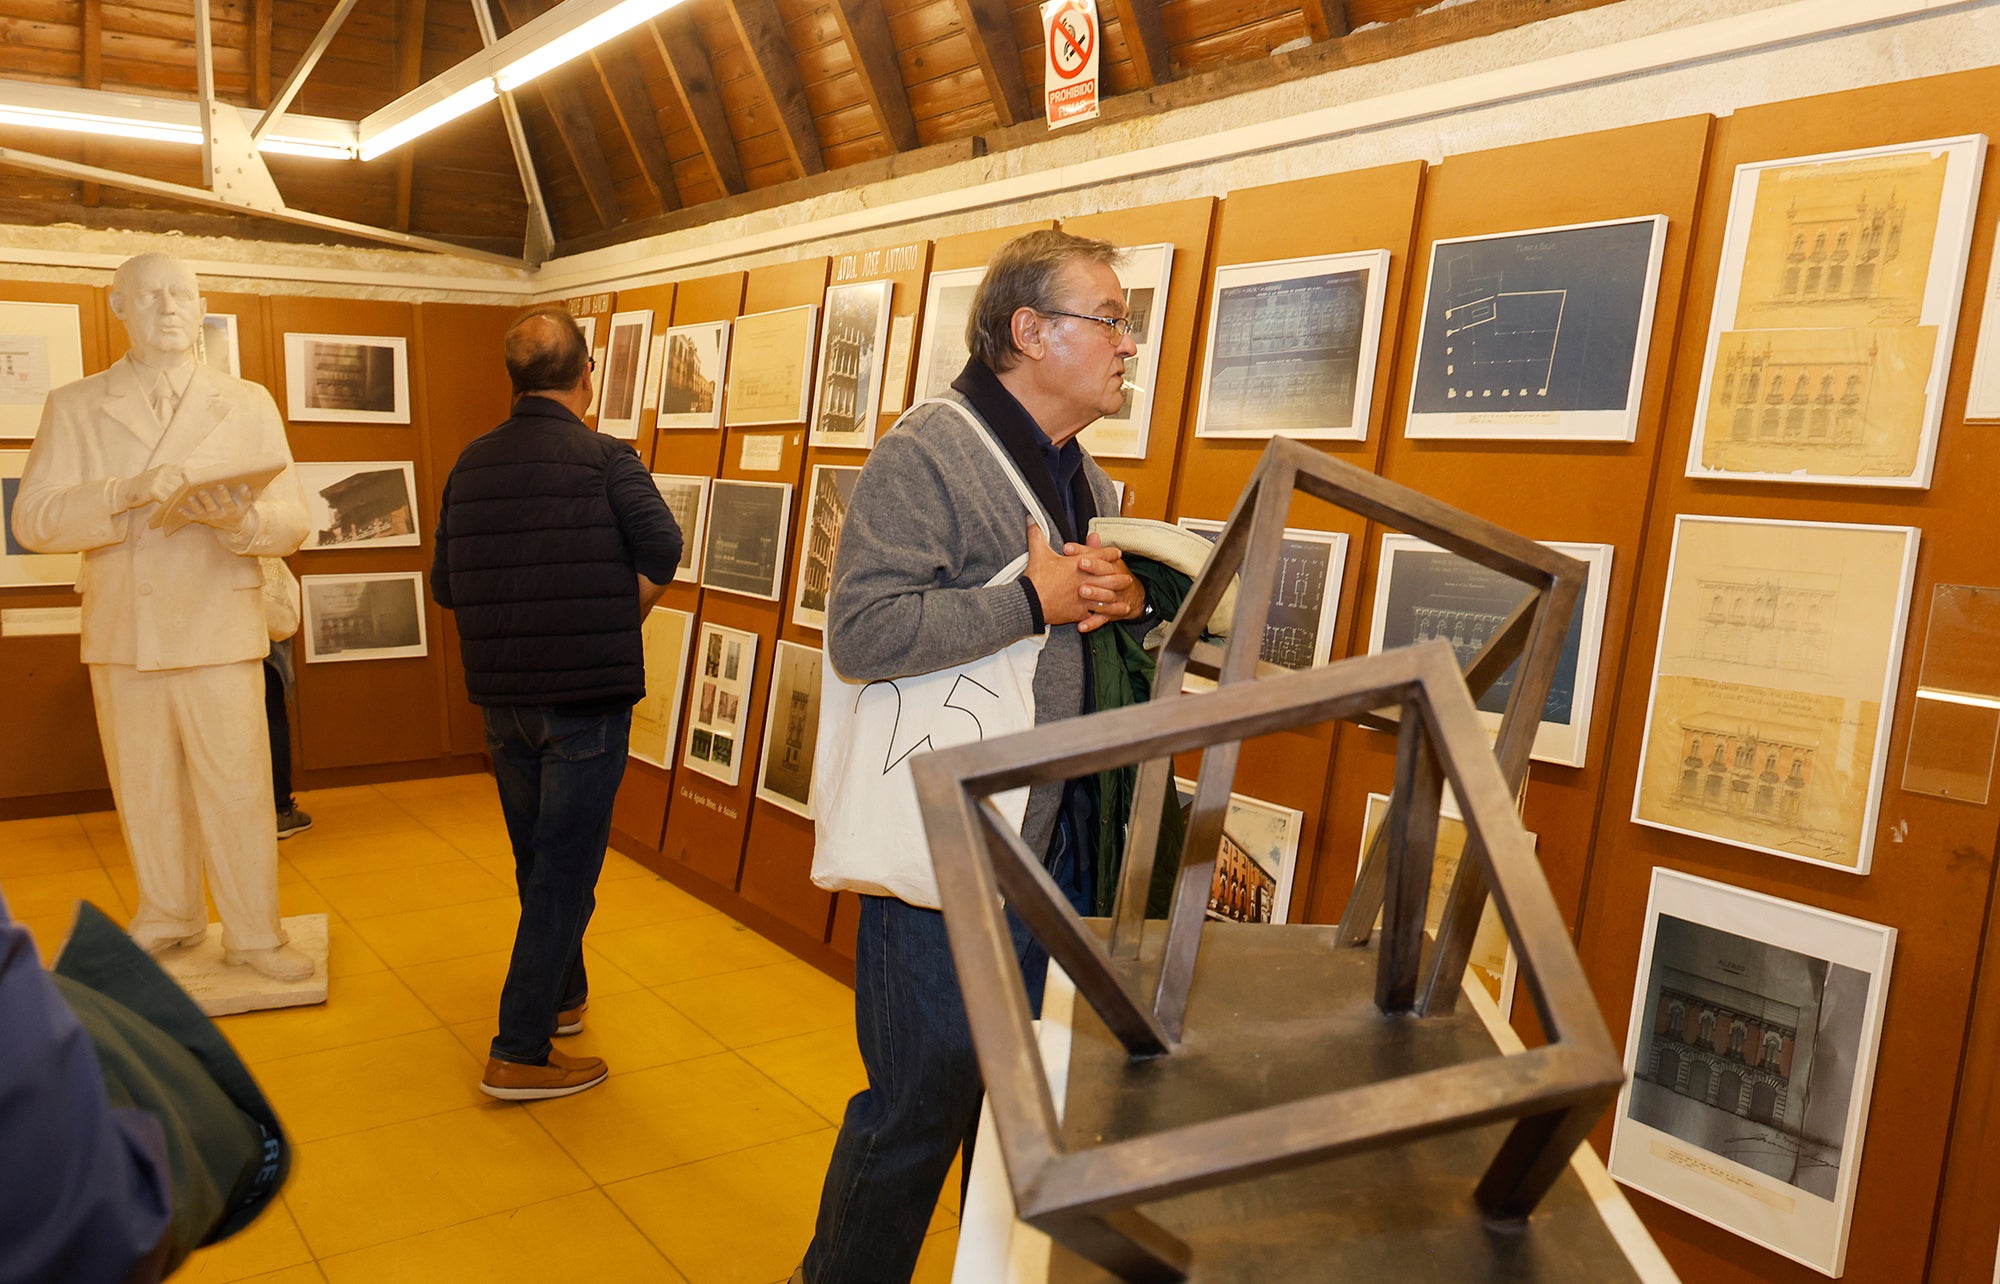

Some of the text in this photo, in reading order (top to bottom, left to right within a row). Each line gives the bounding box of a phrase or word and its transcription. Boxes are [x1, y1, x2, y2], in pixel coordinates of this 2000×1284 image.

[1049, 80, 1094, 105] PROHIBIDO
[1058, 100, 1087, 118] FUMAR
[862, 250, 881, 277] JOSE
[883, 243, 919, 275] ANTONIO
